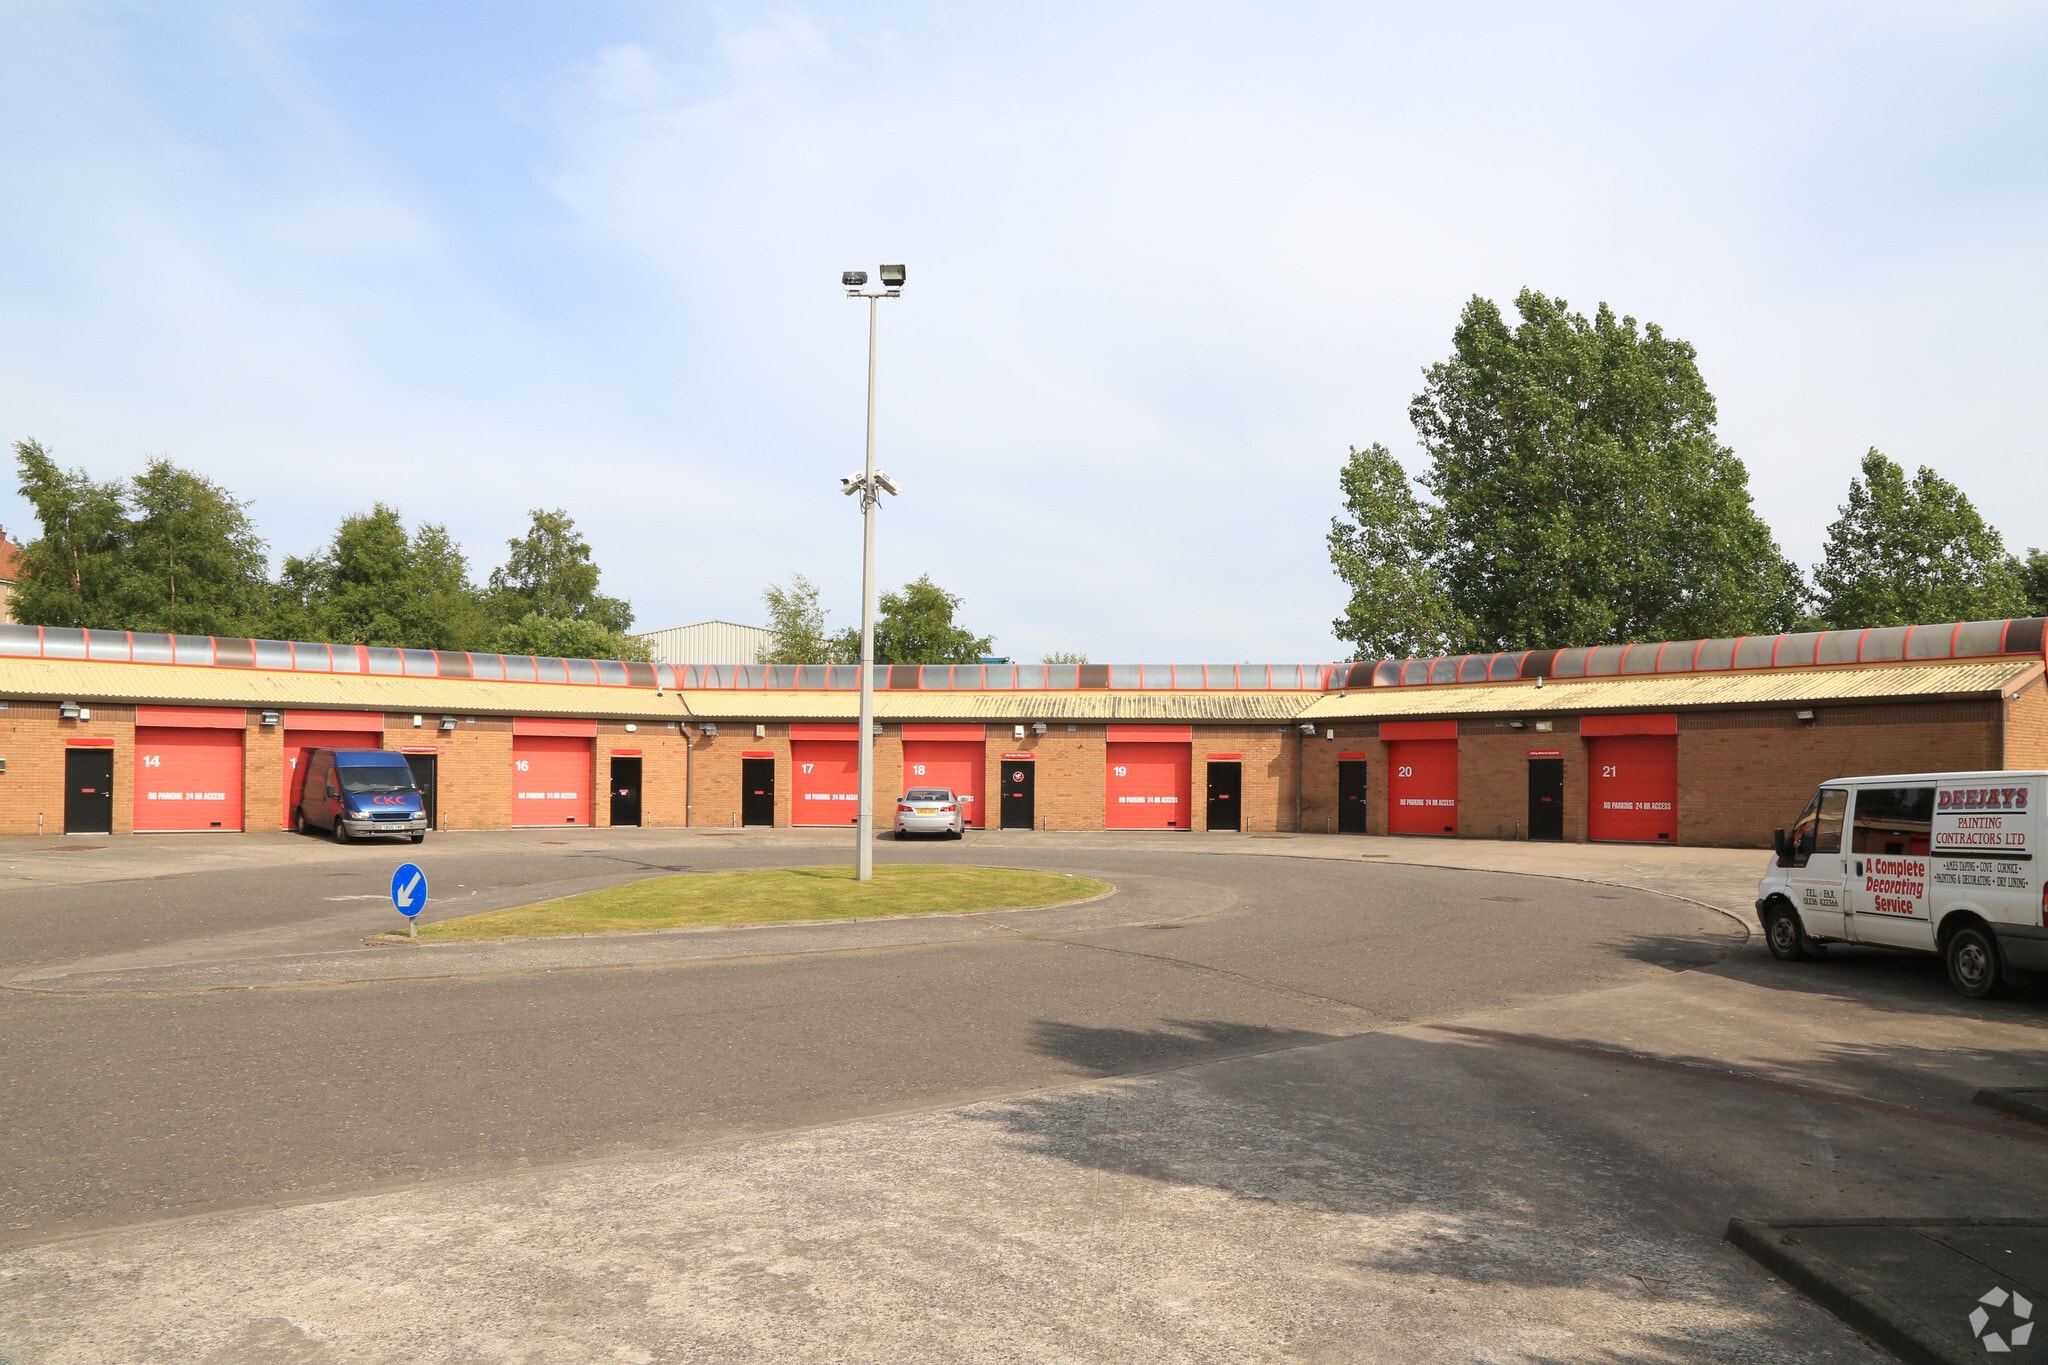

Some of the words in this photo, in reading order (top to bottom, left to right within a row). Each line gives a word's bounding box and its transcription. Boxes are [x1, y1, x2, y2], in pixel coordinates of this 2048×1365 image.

[143, 755, 160, 768] 14
[290, 757, 296, 768] 1
[515, 760, 529, 772] 16
[801, 763, 814, 774] 17
[912, 765, 926, 775] 18
[1113, 766, 1127, 777] 19
[1398, 766, 1412, 777] 20
[1602, 765, 1616, 777] 21
[148, 792, 157, 800] NO
[158, 792, 183, 800] PARKING
[185, 792, 193, 800] 24
[195, 792, 202, 800] HR
[204, 792, 225, 800] ACCESS
[373, 796, 406, 806] CKC
[1938, 788, 2028, 809] DEEJAYS
[1635, 802, 1642, 810] 24
[1644, 802, 1650, 810] HR
[1652, 802, 1671, 810] ACCESS
[1958, 817, 2002, 829] PAINTING
[1936, 832, 2002, 845] CONTRACTORS
[2005, 833, 2025, 845] LTD
[1866, 858, 1872, 873] A
[1875, 858, 1925, 878] Complete
[1959, 861, 1976, 872] TAPING
[1980, 862, 1992, 872] COVE
[1997, 862, 2019, 874] CORNICE
[1936, 873, 1956, 884] PAINTING
[1962, 874, 1991, 886] DECORATING
[1997, 876, 2006, 887] DRY
[2008, 877, 2025, 888] LINING
[1866, 876, 1924, 899] Decorating
[1875, 895, 1913, 915] Service
